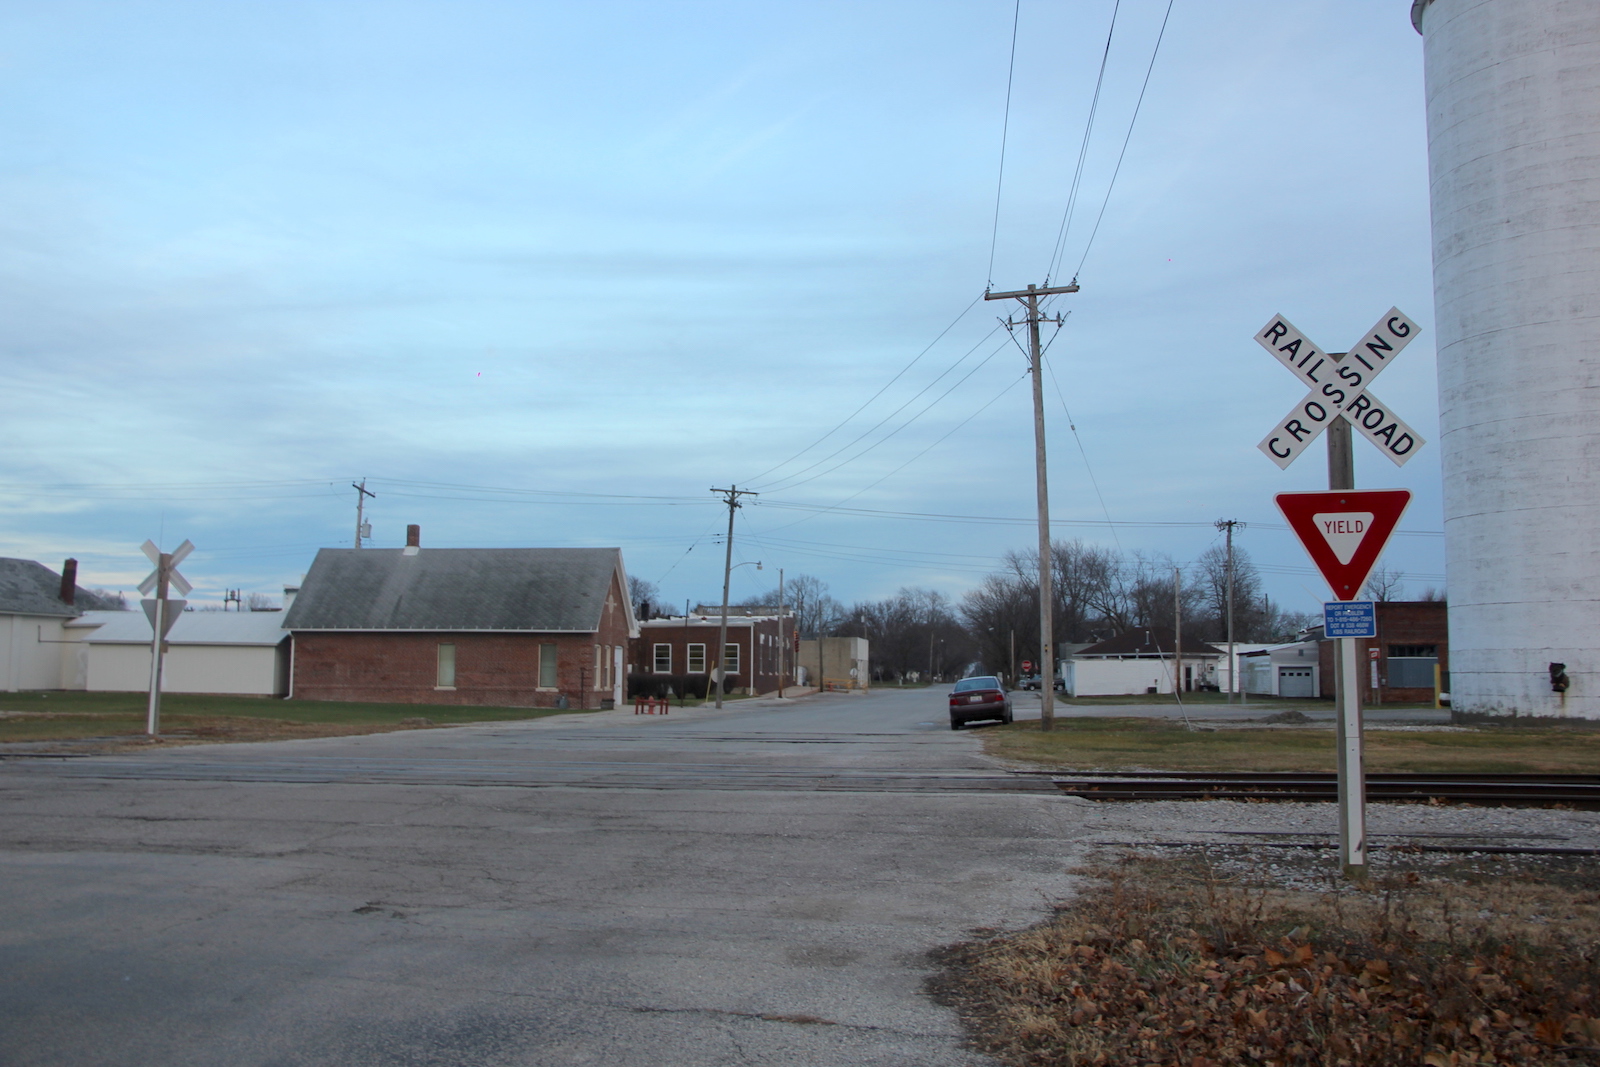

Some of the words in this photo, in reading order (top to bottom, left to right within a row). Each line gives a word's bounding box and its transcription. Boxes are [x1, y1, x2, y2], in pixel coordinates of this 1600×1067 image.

[1263, 320, 1325, 384] RAIL
[1346, 394, 1414, 456] ROAD
[1268, 316, 1410, 459] CROSSING
[1324, 520, 1363, 534] YIELD
